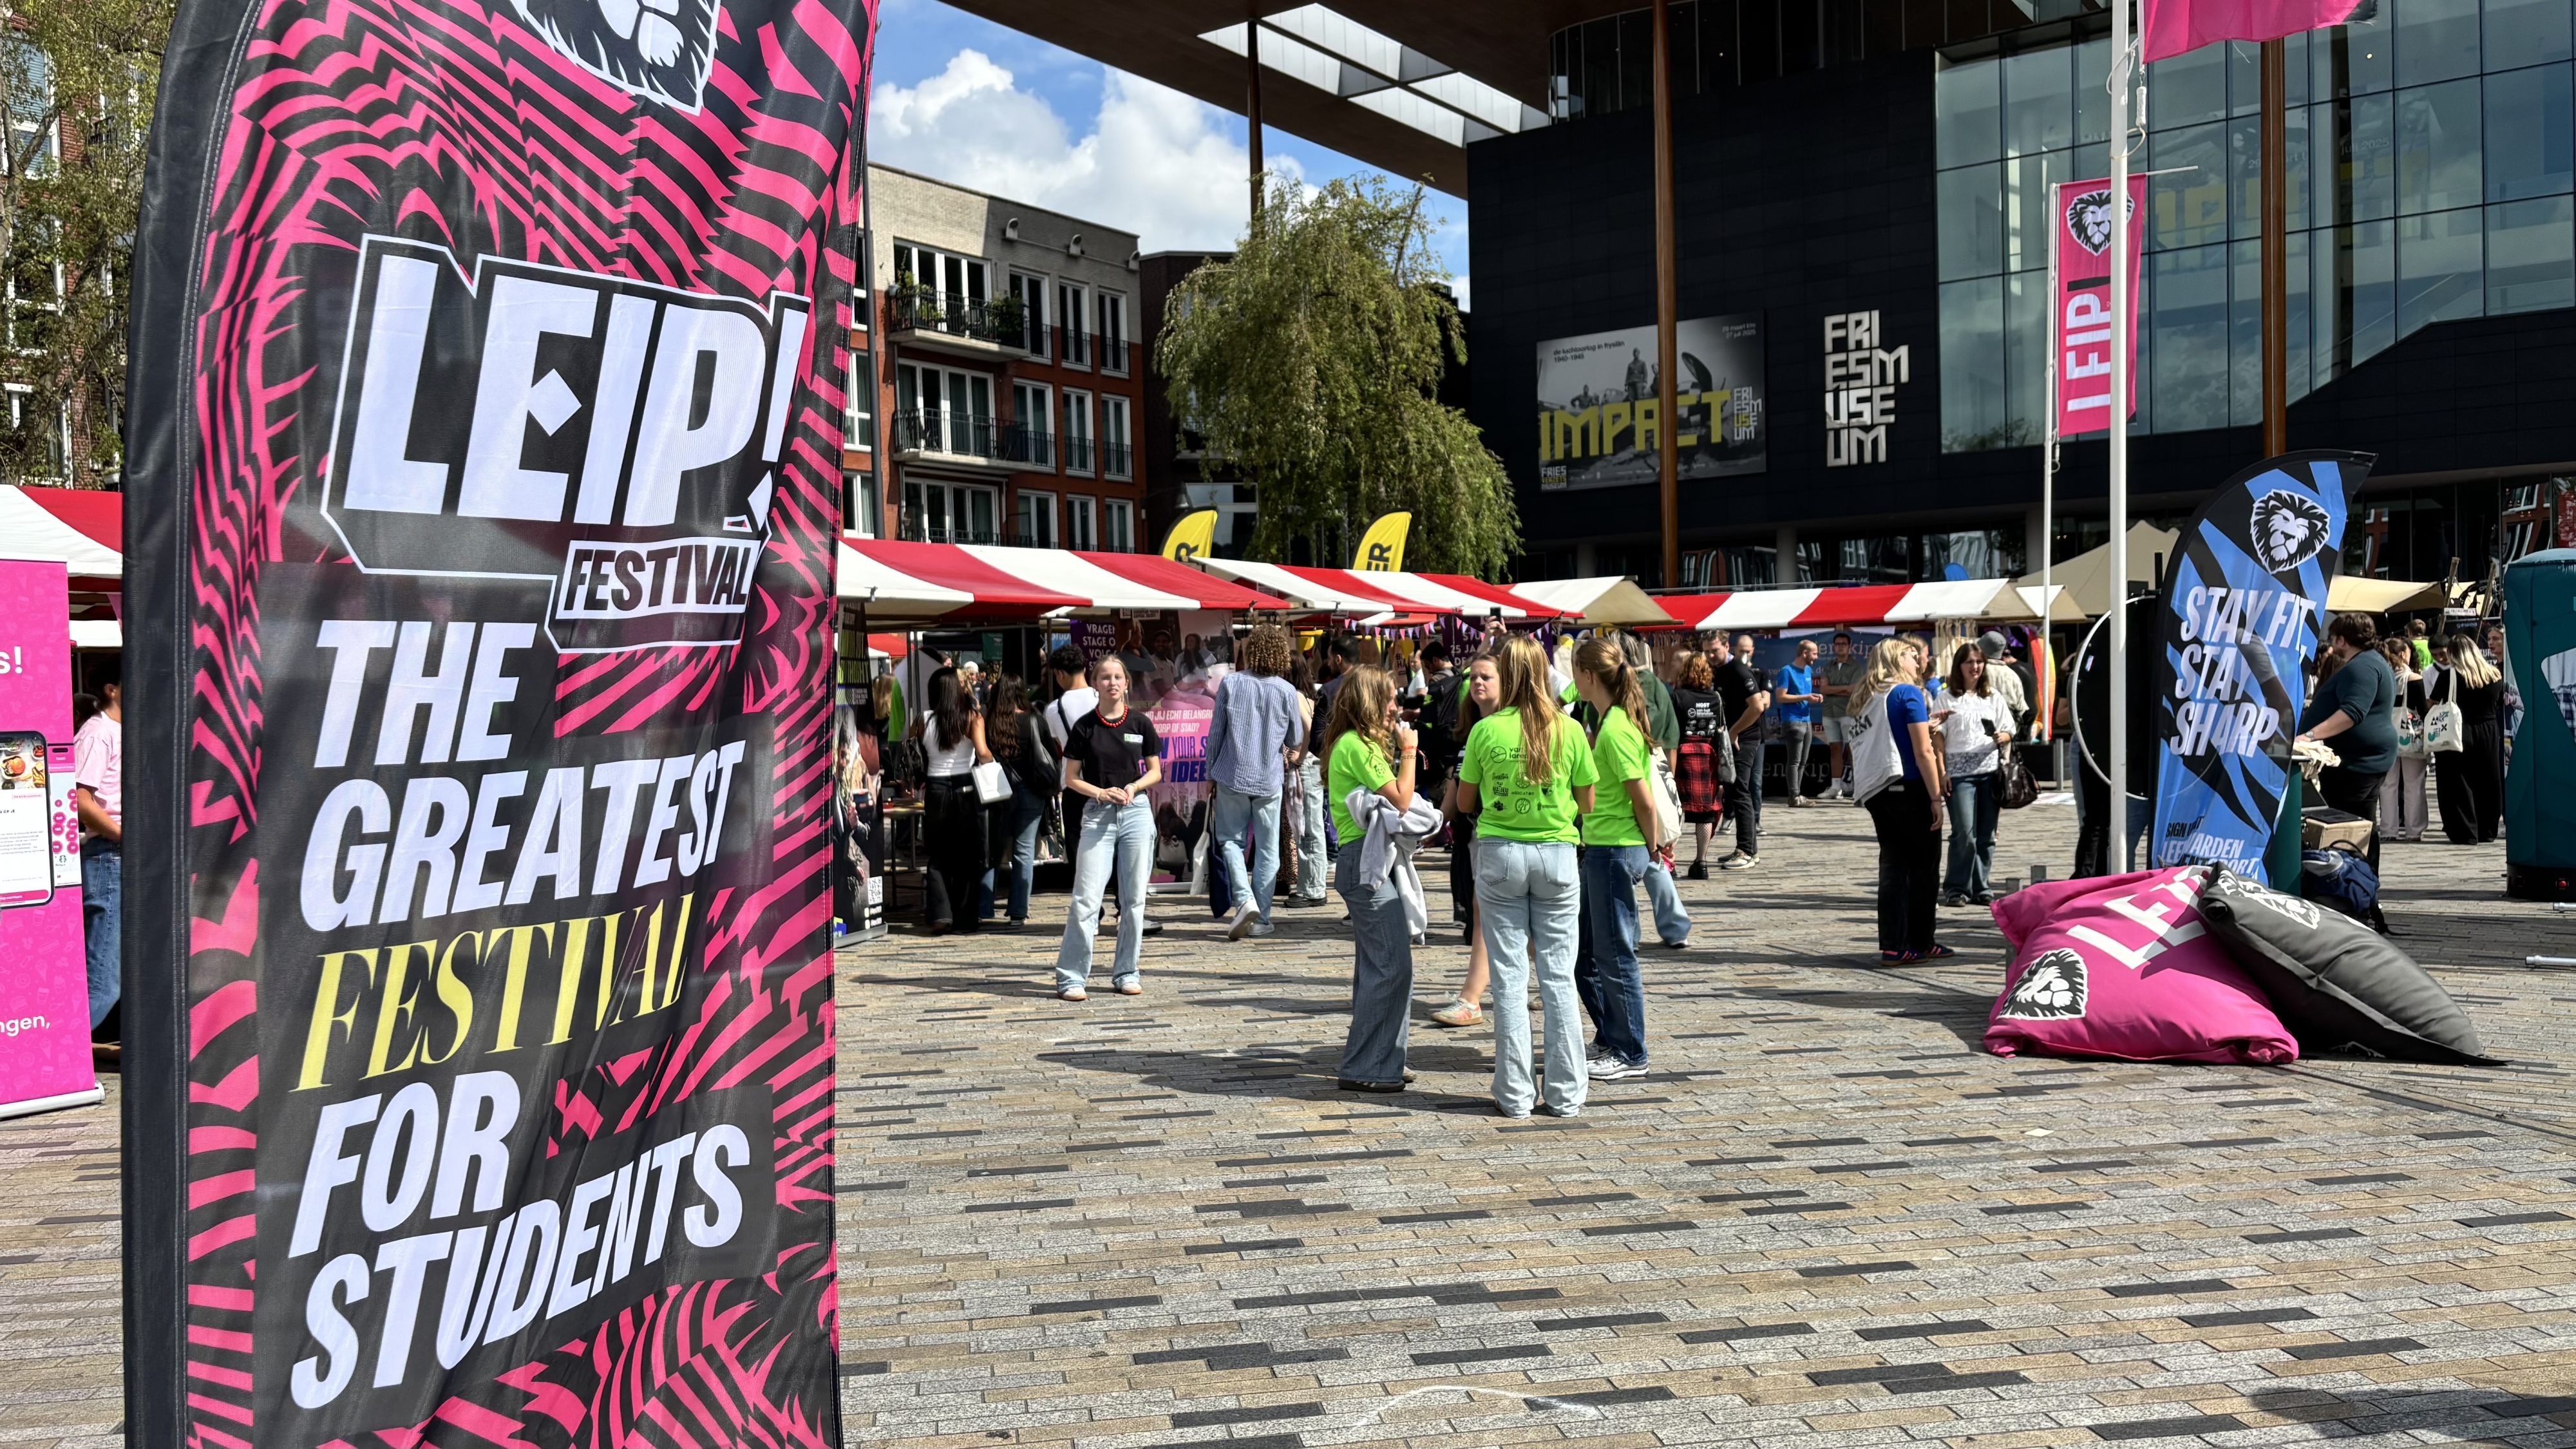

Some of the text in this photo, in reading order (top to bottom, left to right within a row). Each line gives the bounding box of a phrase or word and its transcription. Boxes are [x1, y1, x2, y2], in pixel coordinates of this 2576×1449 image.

[2362, 138, 2390, 151] 2025
[343, 254, 808, 530] LEIP!
[1541, 466, 1567, 477] FRIES
[564, 544, 750, 612] FESTIVAL
[1083, 636, 1106, 647] STAGE
[2181, 586, 2273, 644] STAY
[314, 620, 537, 768] THE
[2175, 644, 2252, 701] STAY
[1166, 709, 1183, 720] ECHT
[1171, 723, 1180, 733] OF
[1180, 722, 1200, 732] STAD?
[2170, 701, 2280, 758] SHARP
[1172, 736, 1195, 759] YOUR
[300, 741, 746, 931] GREATEST
[2166, 822, 2188, 838] SIGN
[289, 891, 695, 1092] FESTIVAL
[289, 1070, 520, 1258] FOR
[290, 1124, 750, 1409] STUDENTS
